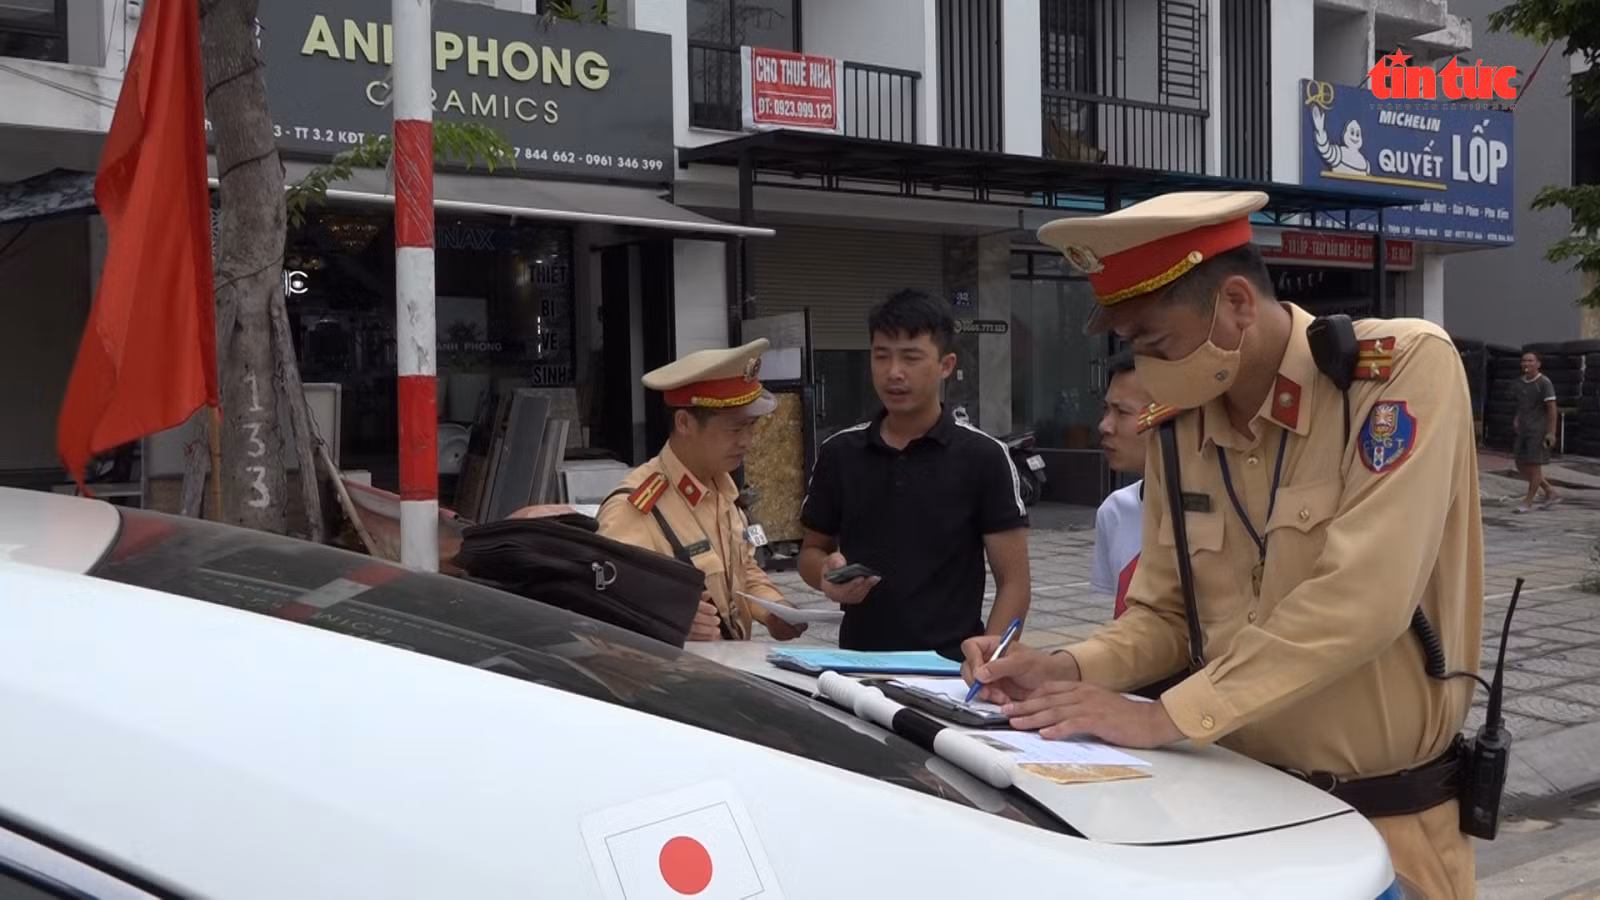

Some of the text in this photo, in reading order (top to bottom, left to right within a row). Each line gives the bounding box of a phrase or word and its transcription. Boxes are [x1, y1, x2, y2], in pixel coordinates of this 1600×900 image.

[435, 31, 610, 90] PHONG
[756, 56, 832, 89] CHO THUÊ NHÀ
[774, 99, 833, 119] 0923.999.123
[1379, 110, 1441, 132] MICHELIN
[312, 129, 334, 142] 3.2
[338, 131, 365, 144] KĐT
[524, 148, 548, 160] 844
[552, 151, 576, 163] 662
[586, 154, 613, 167] 0961
[617, 157, 639, 169] 346
[642, 159, 663, 171] 399
[1378, 140, 1443, 178] QUYẾT
[1452, 119, 1508, 185] LỐP
